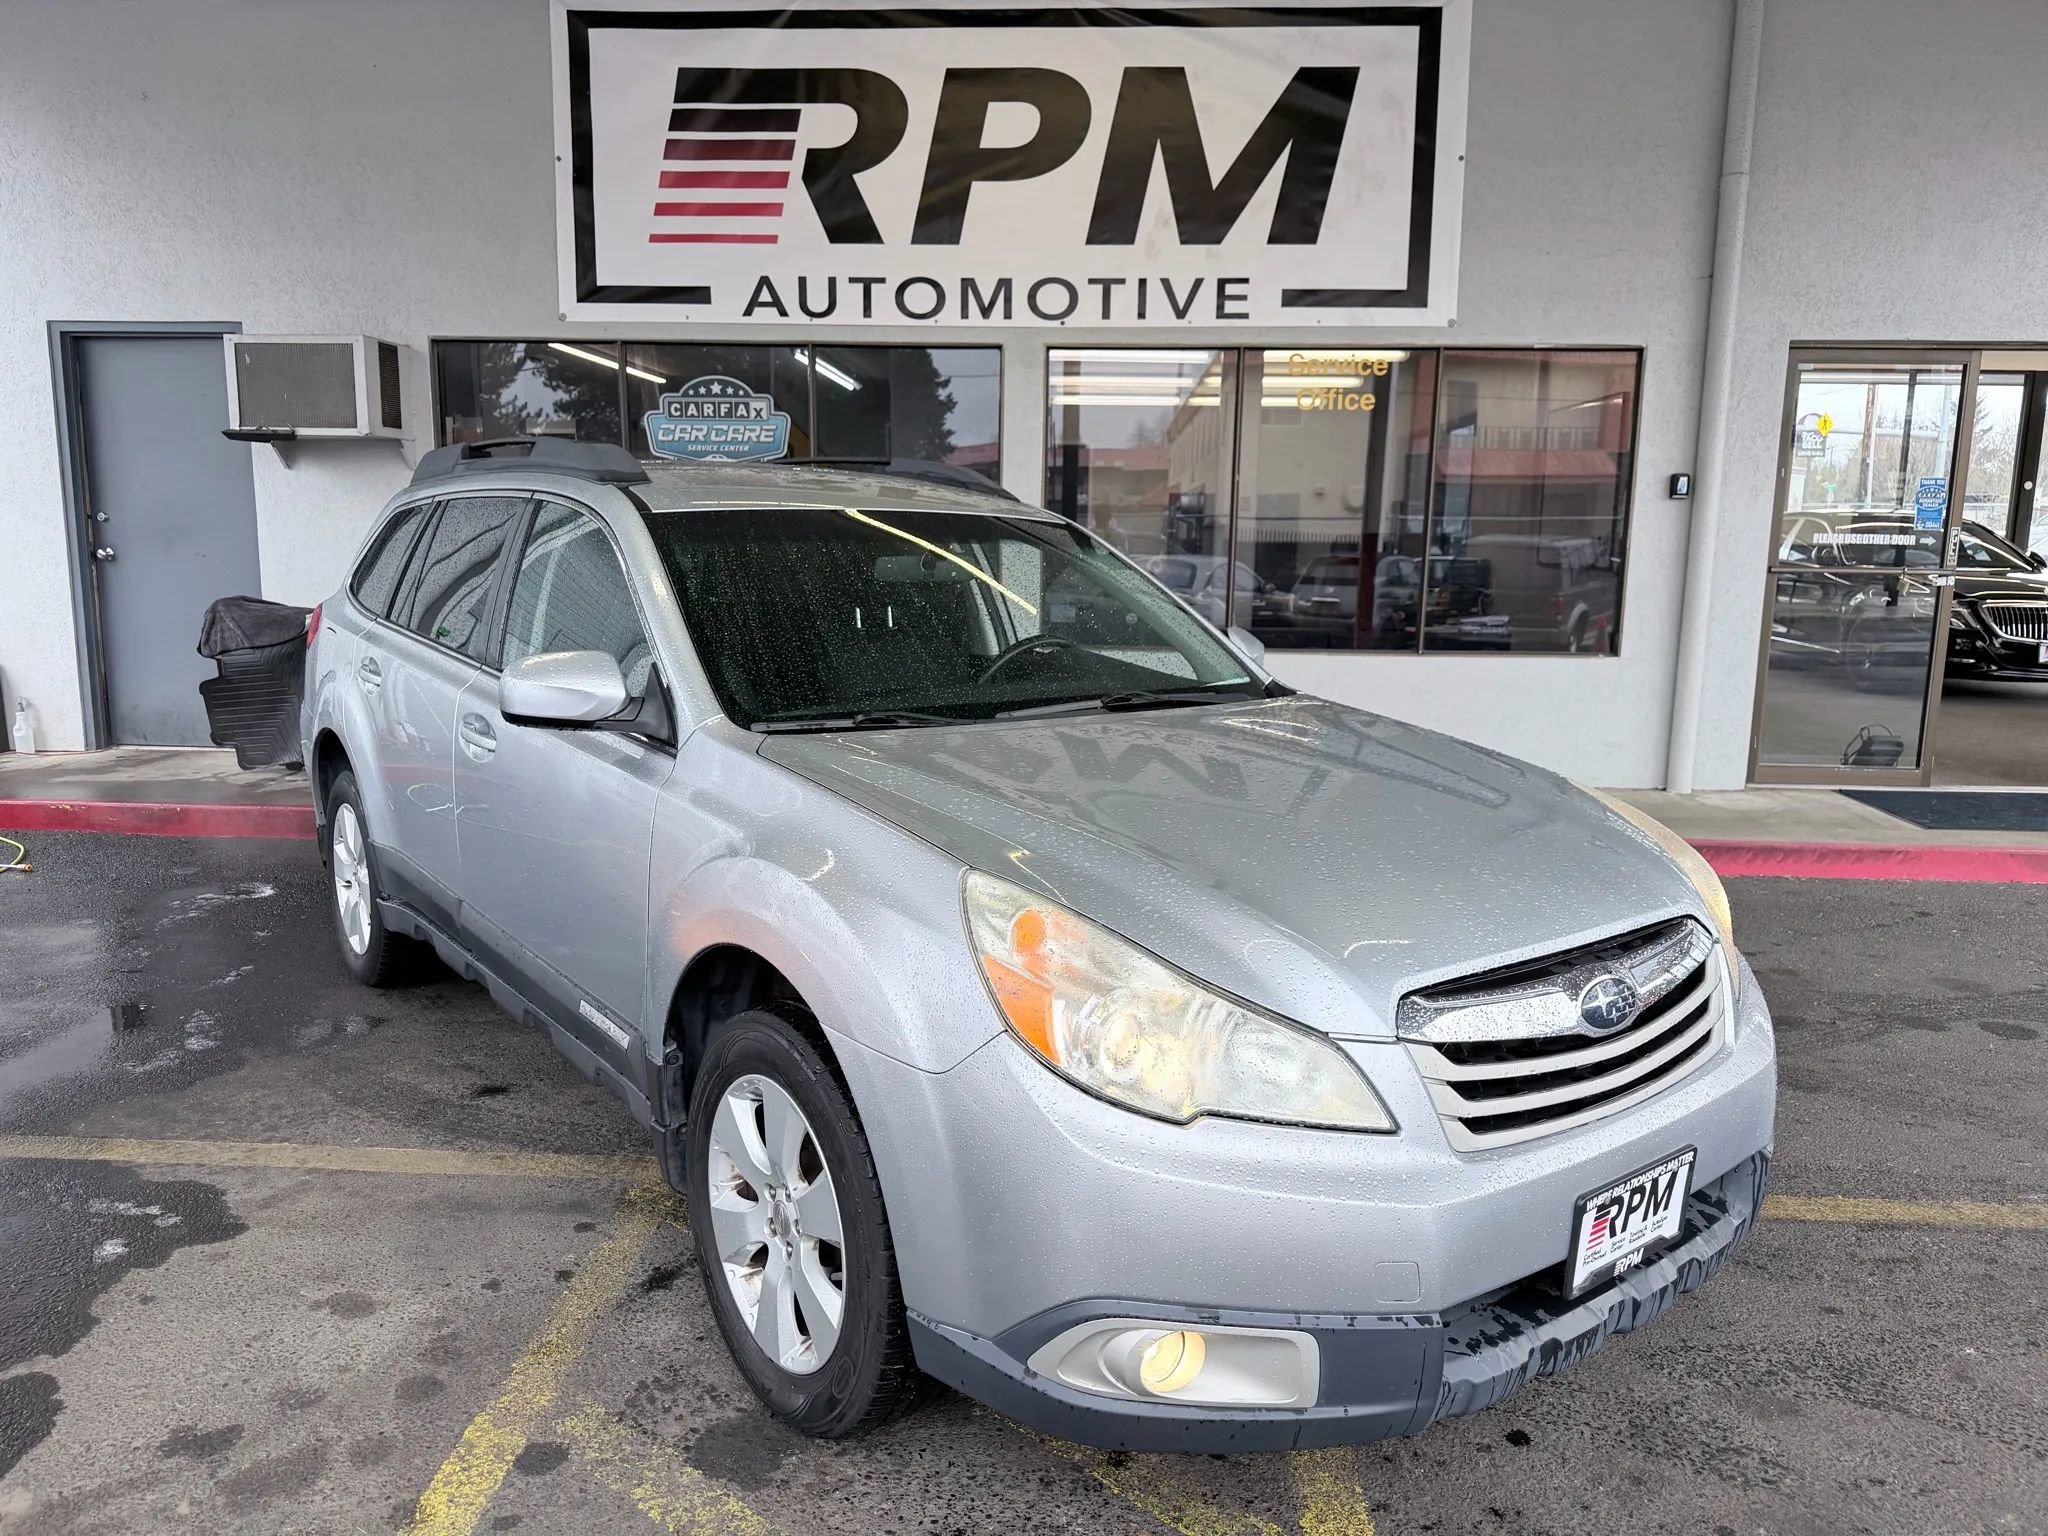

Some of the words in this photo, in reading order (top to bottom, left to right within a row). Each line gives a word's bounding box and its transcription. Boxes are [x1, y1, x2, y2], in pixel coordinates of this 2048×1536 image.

[649, 66, 1361, 246] RPM
[742, 274, 1251, 322] AUTOMOTIVE
[1289, 353, 1389, 377] Service
[669, 402, 765, 420] CARFAX
[1296, 387, 1377, 412] Office
[657, 423, 708, 442] CAR
[710, 424, 777, 443] CARE
[687, 444, 717, 452] SERVICE
[719, 444, 750, 452] CENTER
[1812, 532, 1845, 545] PLEASE
[1844, 533, 1862, 545] USE
[1862, 533, 1891, 545] OTHER
[1890, 534, 1917, 546] DOOR
[1949, 529, 1959, 556] PULL
[1586, 1188, 1613, 1212] WHERE
[1611, 1164, 1668, 1199] RELATIONSHIPS
[1665, 1151, 1695, 1173] MATTER
[1585, 1171, 1679, 1252] RPM
[1613, 1247, 1645, 1277] RPM
